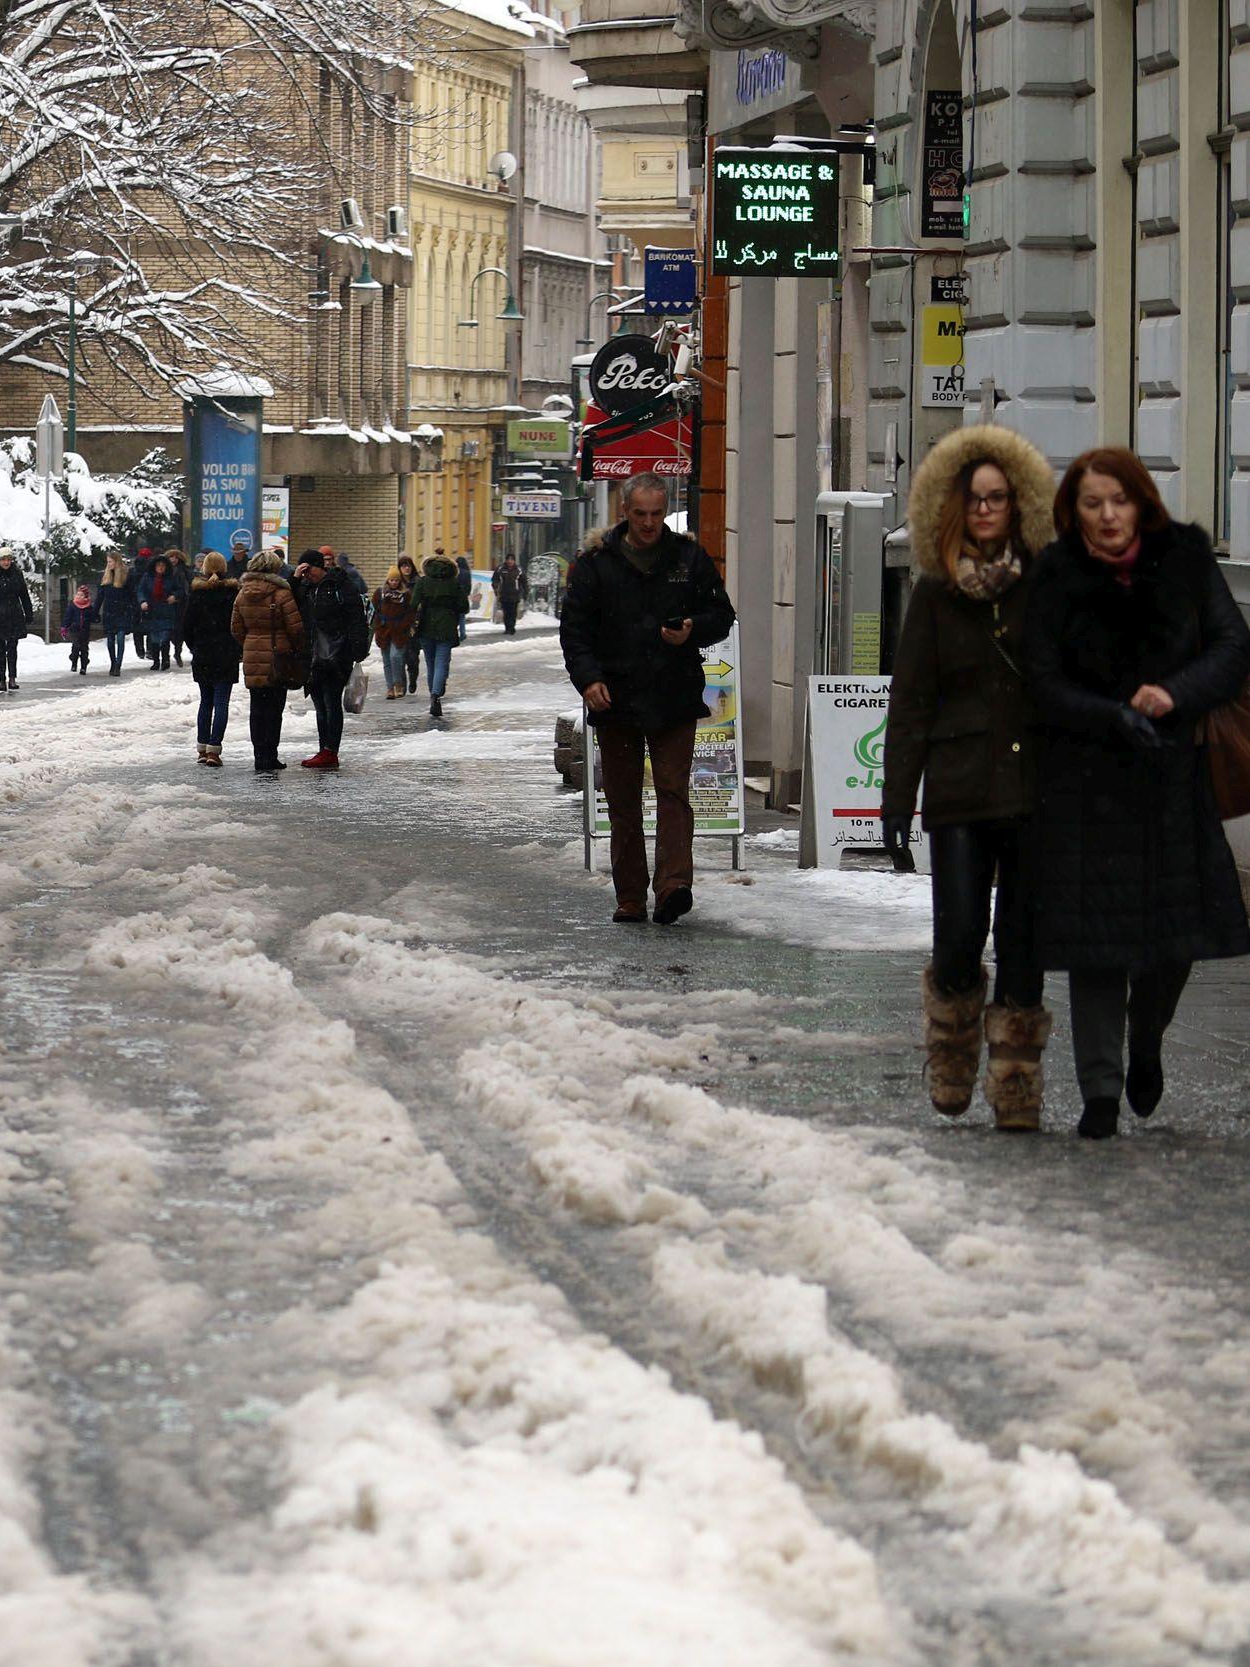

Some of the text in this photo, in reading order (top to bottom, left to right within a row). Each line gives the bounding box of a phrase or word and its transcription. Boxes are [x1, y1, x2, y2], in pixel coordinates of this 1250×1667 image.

[717, 163, 834, 181] MASSAGE &
[741, 184, 811, 201] SAUNA
[735, 205, 815, 222] LOUNGE
[662, 264, 680, 272] ATM
[598, 353, 667, 390] Peko
[932, 376, 964, 392] TAT
[932, 393, 960, 401] BODY
[202, 463, 238, 476] VOLIO
[202, 479, 246, 490] DA SMO
[202, 494, 242, 505] SVI NA
[202, 508, 244, 520] BROJU!
